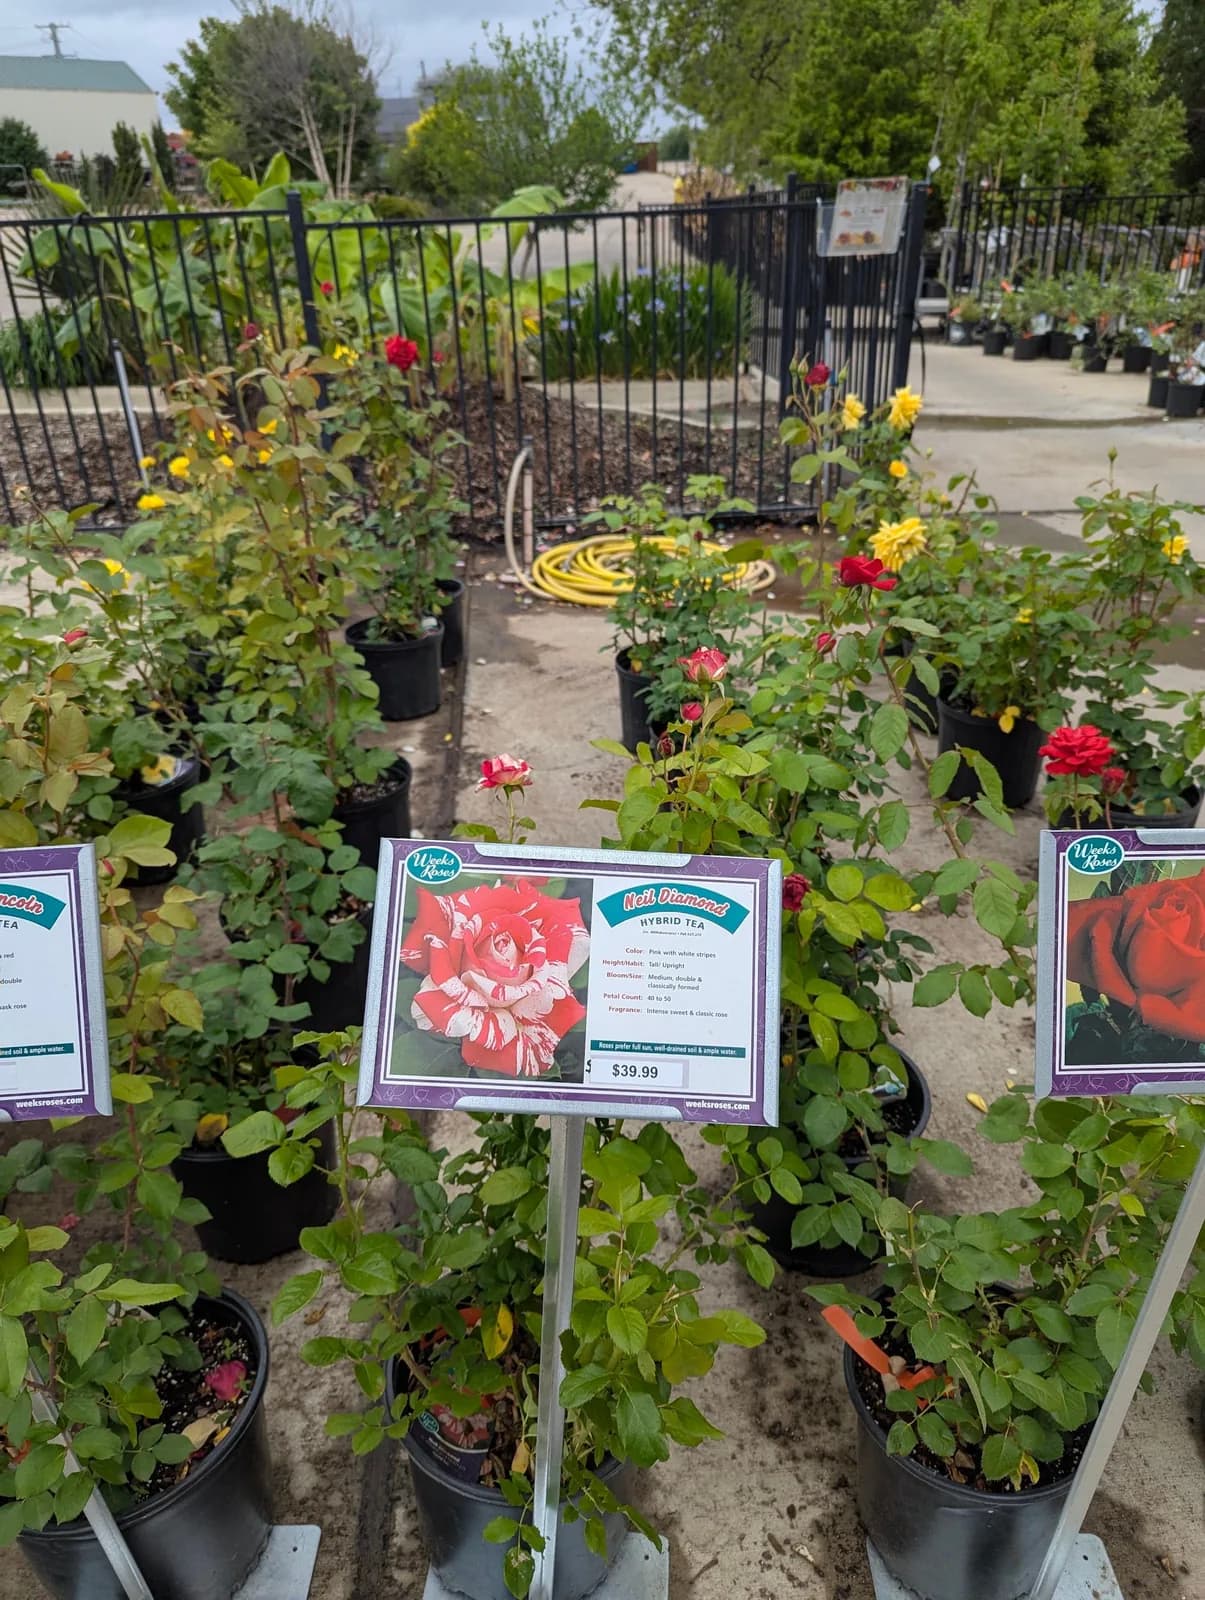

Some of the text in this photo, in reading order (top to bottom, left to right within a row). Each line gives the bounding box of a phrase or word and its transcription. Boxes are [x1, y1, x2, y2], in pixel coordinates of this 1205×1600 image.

[1073, 841, 1117, 858] Weeks
[413, 852, 455, 868] Weeks
[1081, 854, 1118, 870] Roses
[420, 864, 455, 880] Roses
[624, 888, 729, 916] Neil Diamond
[640, 917, 705, 930] HYBRID TEA
[30, 1046, 46, 1055] ample
[654, 1044, 687, 1052] well-drained
[612, 1064, 658, 1078] $39.99
[16, 1096, 83, 1108] weeksroses.com
[686, 1100, 750, 1110] weeksroses.com
